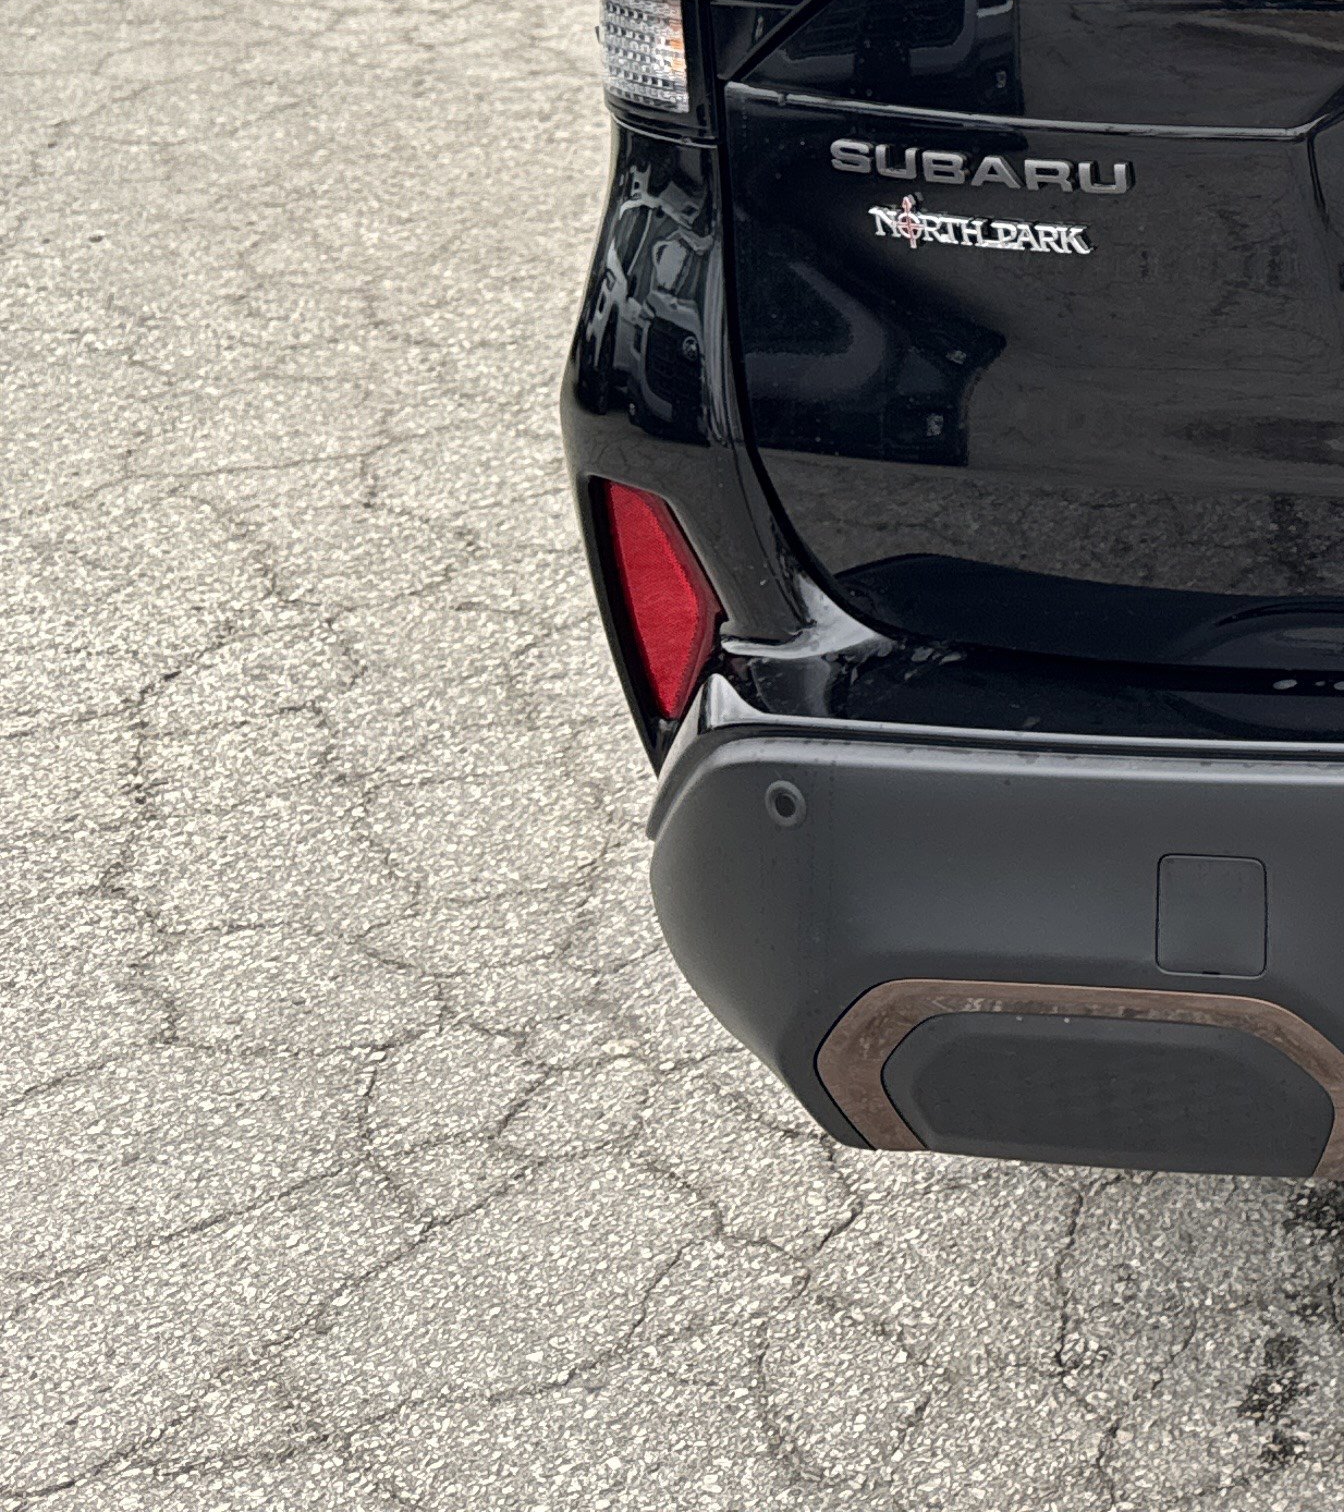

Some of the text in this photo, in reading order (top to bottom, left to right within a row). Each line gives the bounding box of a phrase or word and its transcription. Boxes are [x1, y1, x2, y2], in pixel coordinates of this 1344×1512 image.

[829, 138, 1134, 194] SUBARU
[868, 195, 1094, 255] NORTH PARK
